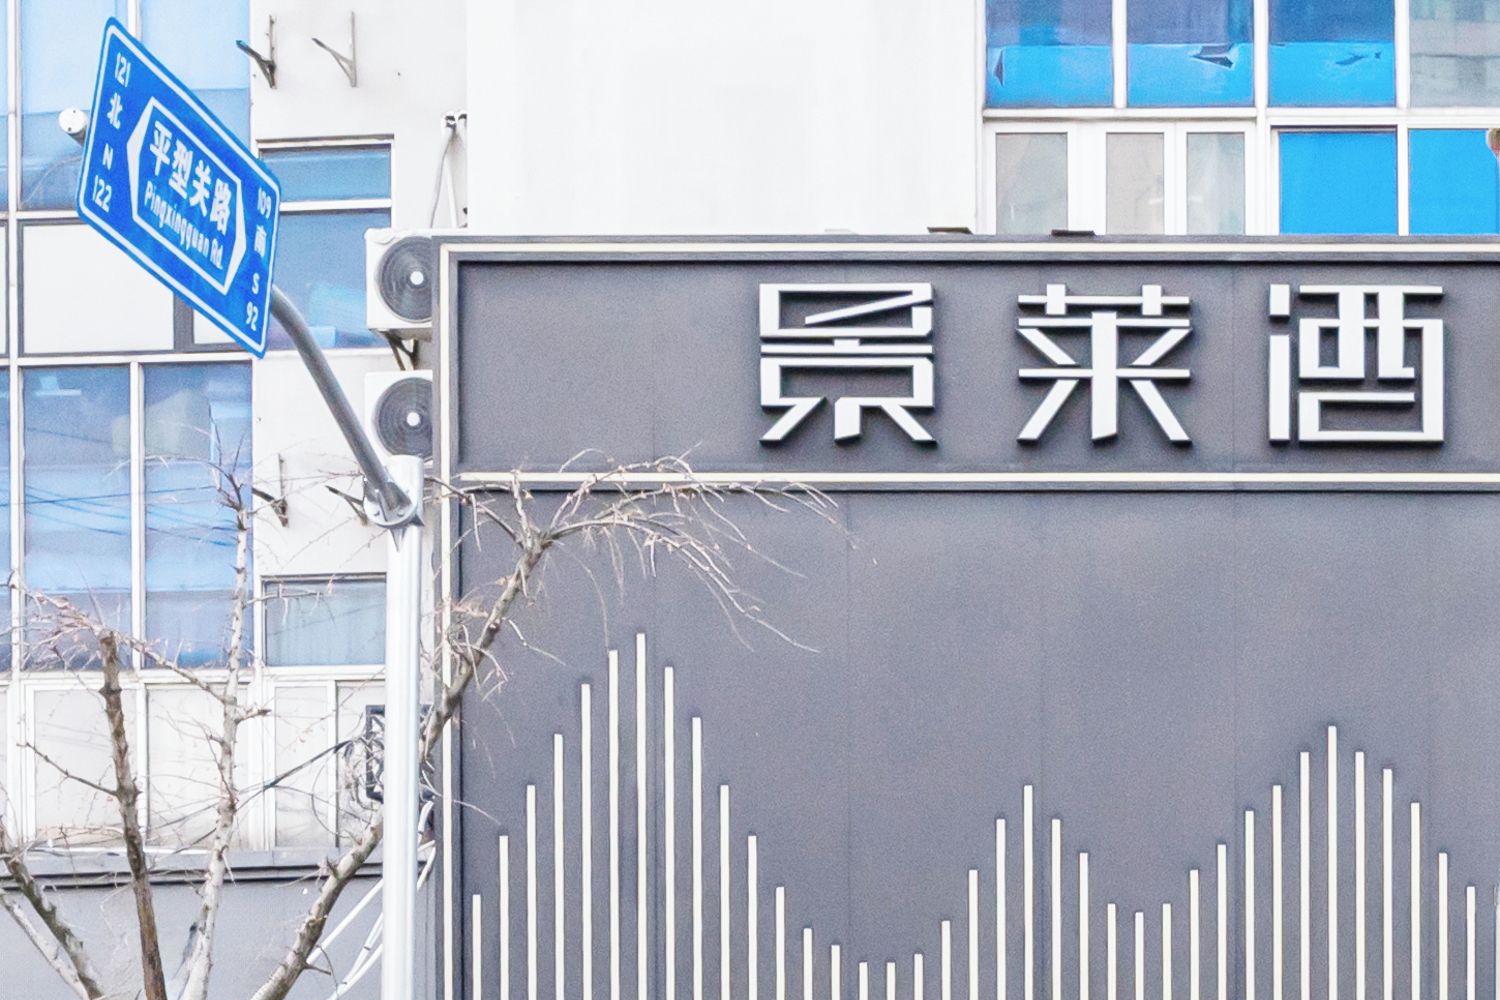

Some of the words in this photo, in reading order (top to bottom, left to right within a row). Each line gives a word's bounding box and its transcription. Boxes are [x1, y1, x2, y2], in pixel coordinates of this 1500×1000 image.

[114, 52, 132, 88] 121
[106, 92, 123, 129] 北
[102, 144, 114, 171] N
[92, 174, 112, 213] 122
[149, 120, 232, 236] 平型关路
[144, 181, 209, 258] Pingxingguan
[257, 187, 272, 220] 109
[254, 225, 267, 259] 南
[251, 272, 260, 295] S
[246, 301, 258, 332] 92
